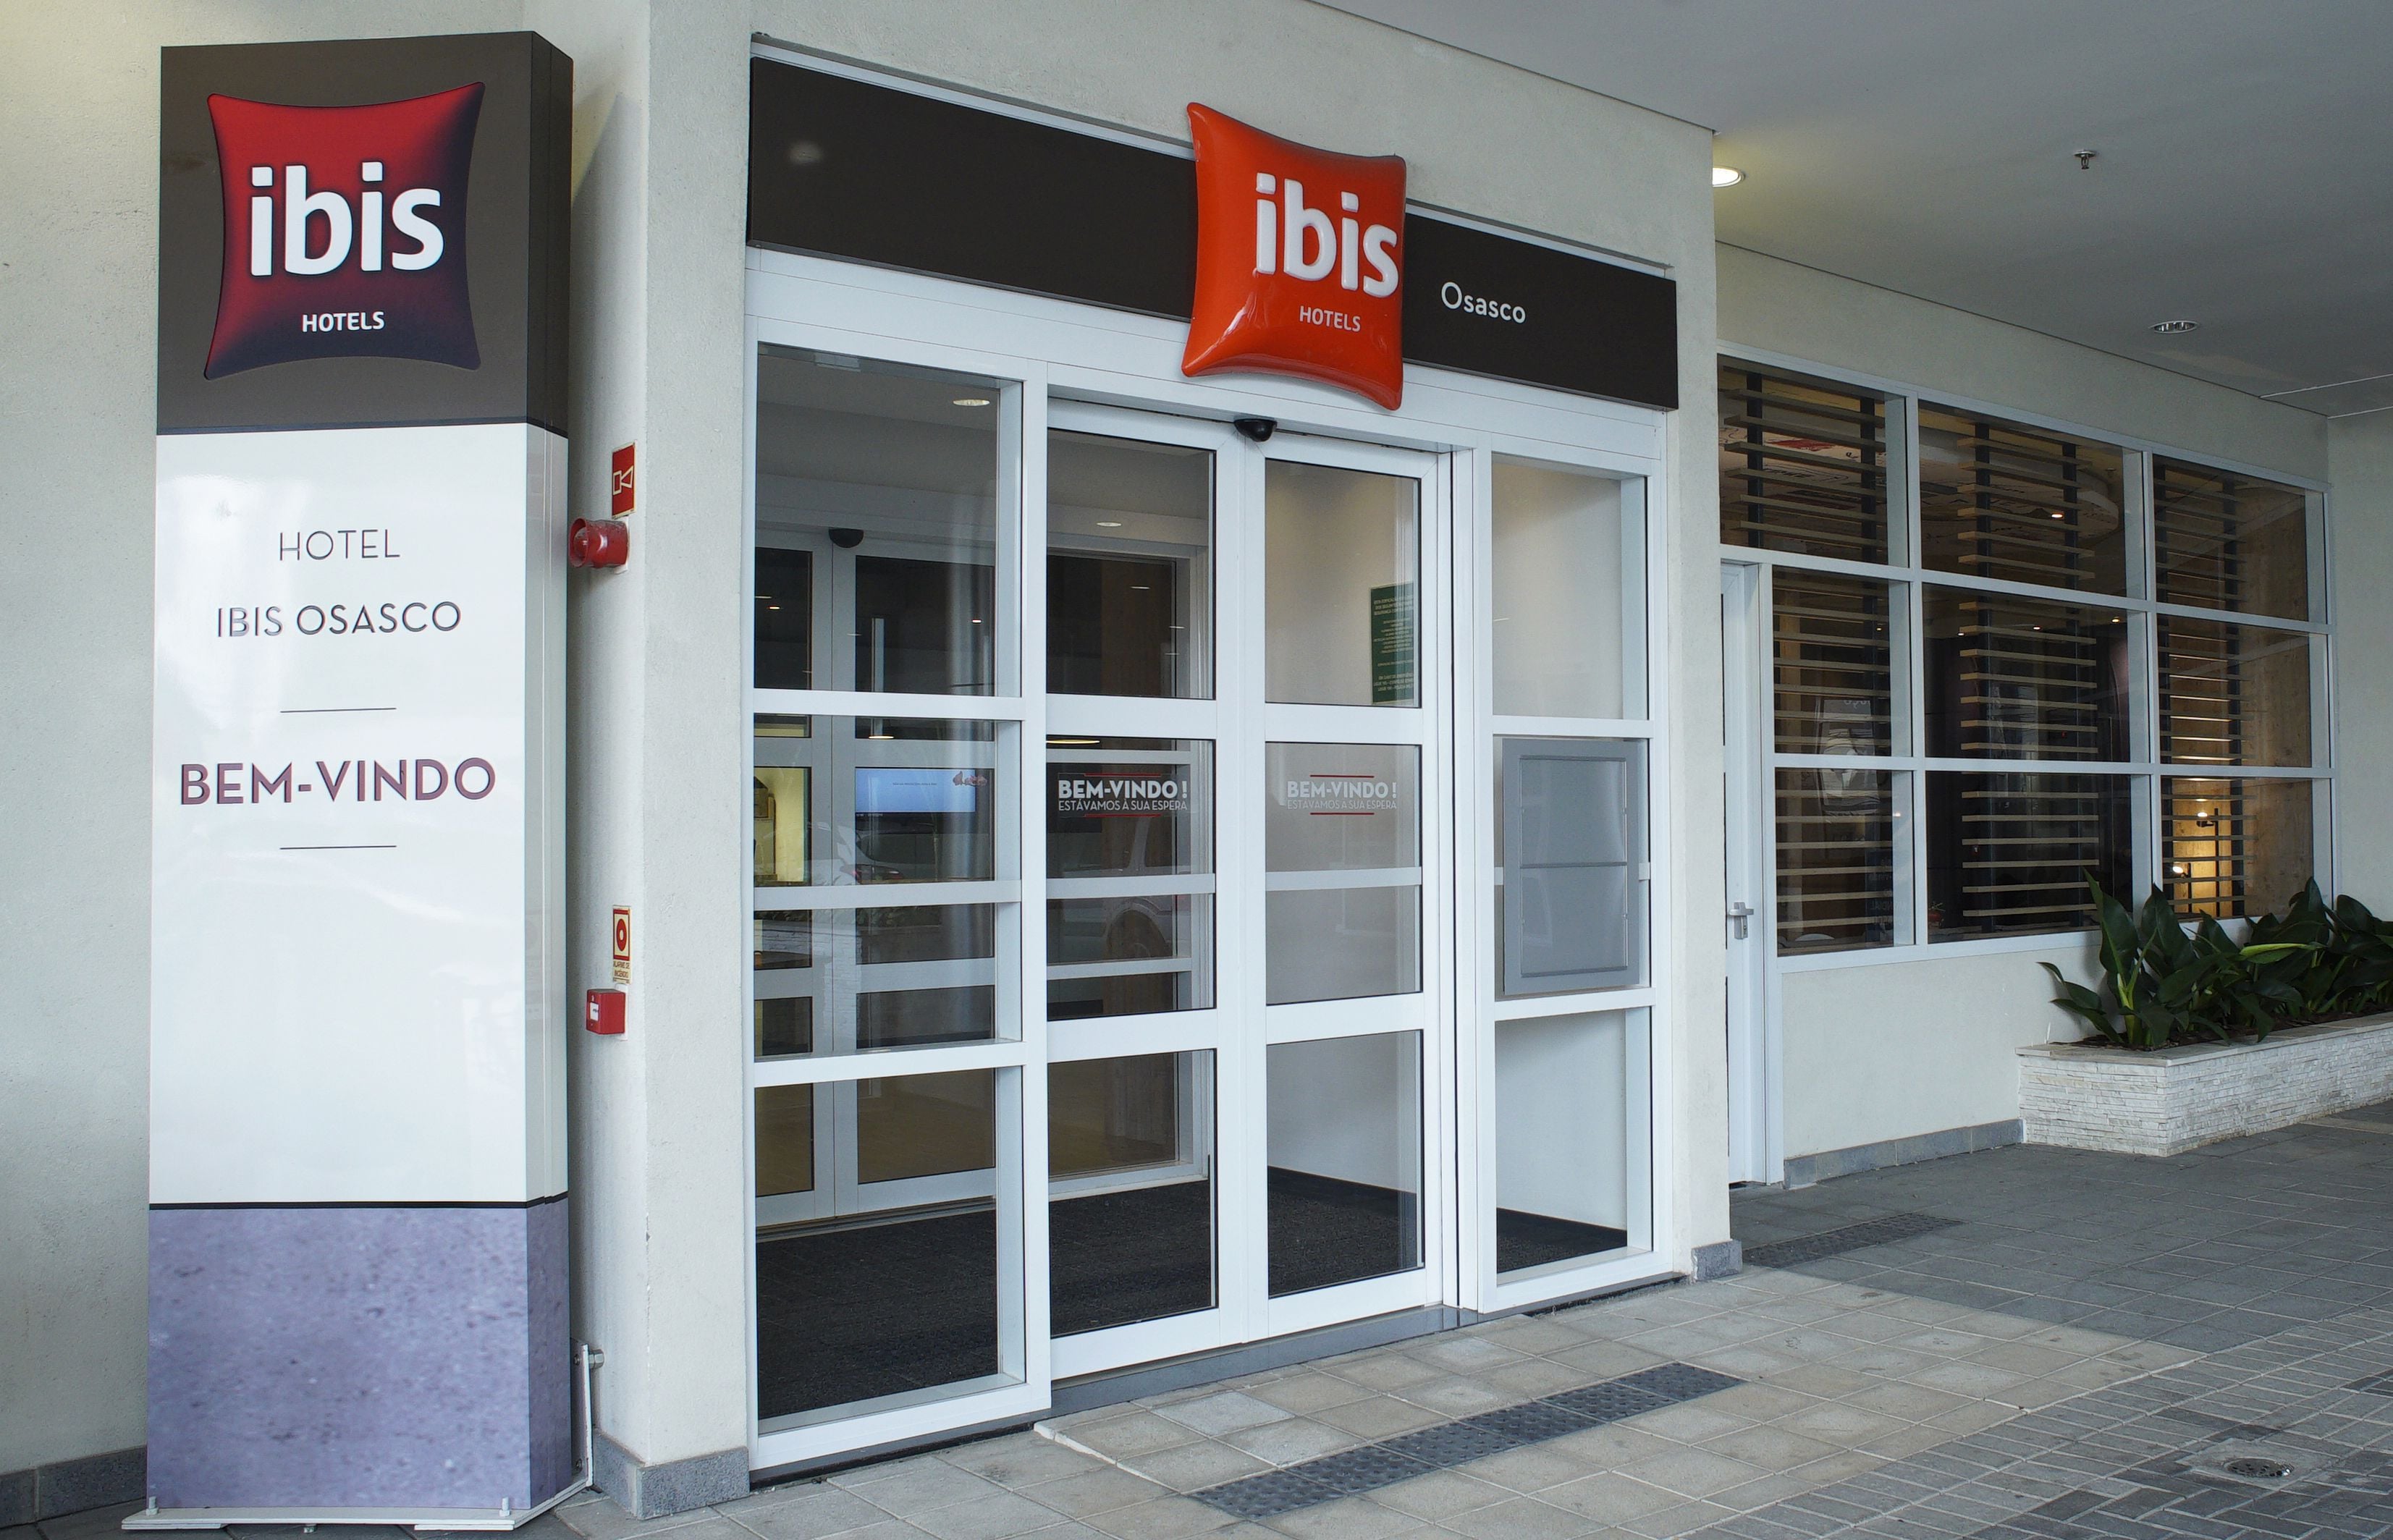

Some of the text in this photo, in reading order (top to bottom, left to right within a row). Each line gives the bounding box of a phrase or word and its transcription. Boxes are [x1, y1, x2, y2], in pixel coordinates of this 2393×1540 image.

[251, 161, 444, 276] ibis
[1256, 172, 1398, 297] ibis
[1299, 305, 1361, 332] HOTELS
[1440, 282, 1527, 323] Osasco
[302, 311, 385, 332] HOTELS
[279, 528, 400, 562] HOTEL
[217, 601, 461, 638] IBIS OSASCO
[180, 757, 496, 805] BEM-VINDO
[1058, 799, 1120, 811] ESTÁVAMOS
[1131, 800, 1150, 811] SUA
[1152, 800, 1188, 811] ESPERA
[1348, 800, 1365, 809] SUA
[1366, 800, 1397, 810] ESPERA
